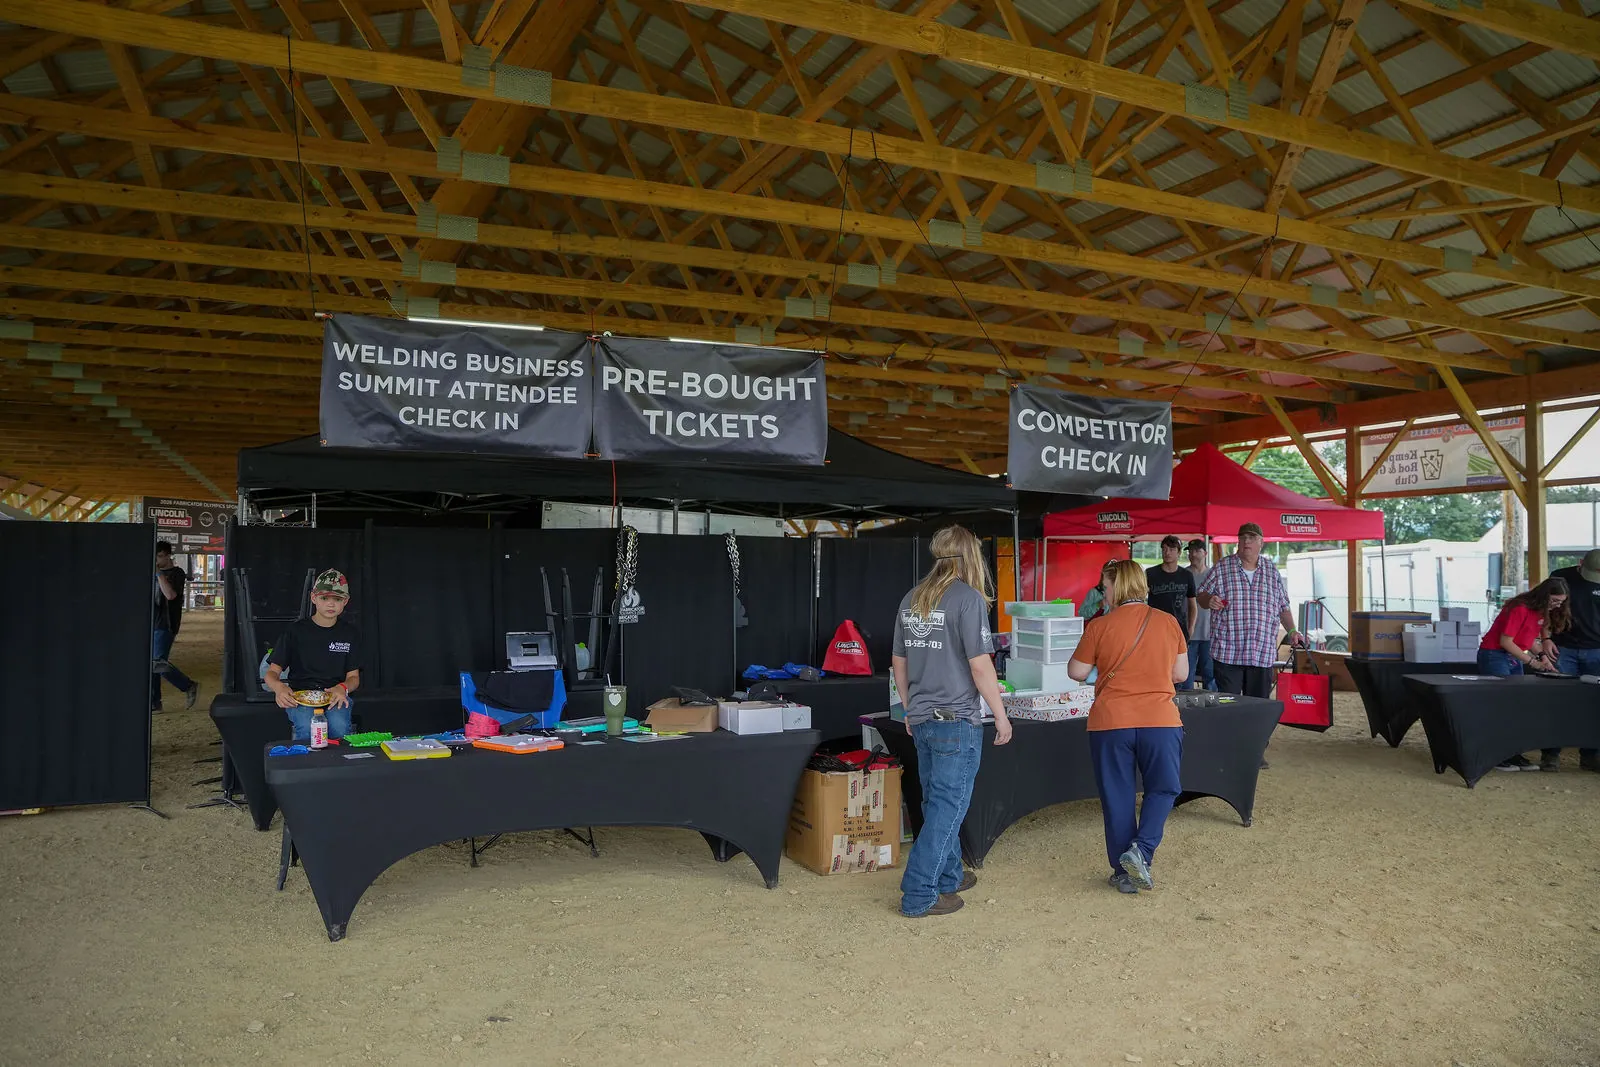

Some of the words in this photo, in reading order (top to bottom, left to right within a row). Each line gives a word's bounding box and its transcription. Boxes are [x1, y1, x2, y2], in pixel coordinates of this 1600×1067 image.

[332, 341, 458, 371] WELDING
[466, 353, 585, 378] BUSINESS
[338, 371, 437, 398] SUMMIT
[447, 380, 578, 405] ATTENDEE
[602, 366, 817, 401] PRE-BOUGHT
[397, 405, 487, 430] CHECK
[494, 412, 520, 431] IN
[642, 409, 780, 439] TICKETS
[1017, 408, 1167, 446] COMPETITOR
[1040, 445, 1123, 474] CHECK
[1126, 454, 1147, 476] IN
[150, 508, 185, 518] LINCOLN
[158, 518, 189, 526] ELECTRIC
[1097, 512, 1128, 522] LINCOLN
[1282, 515, 1314, 525] LINCOLN
[1104, 522, 1131, 530] ELECTRIC
[1290, 526, 1318, 534] ELECTRIC
[314, 727, 322, 745] Wawa
